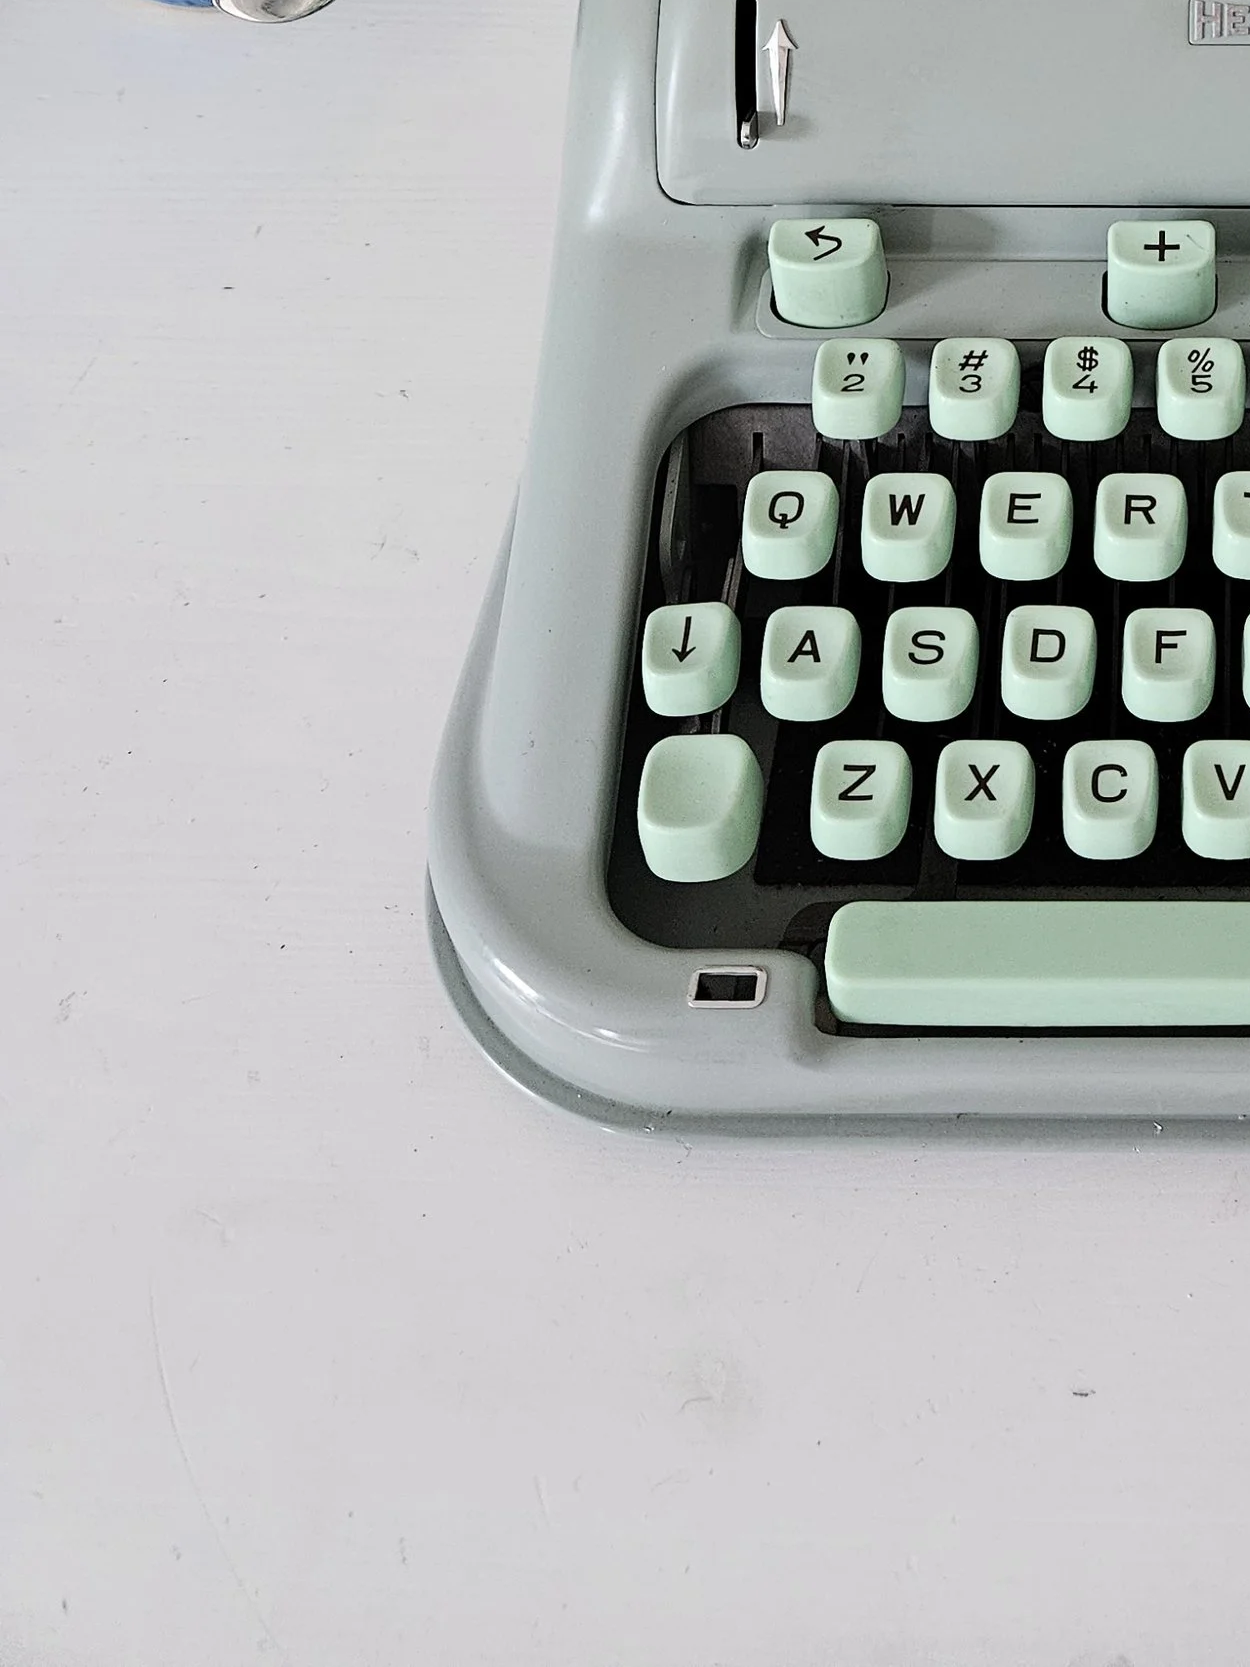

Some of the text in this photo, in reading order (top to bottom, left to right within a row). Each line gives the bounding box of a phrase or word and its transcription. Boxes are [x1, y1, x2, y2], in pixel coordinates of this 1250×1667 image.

[1076, 346, 1099, 372] $
[1187, 347, 1215, 373] %
[840, 373, 865, 392] 2
[959, 374, 982, 393] 3
[1072, 374, 1098, 394] 4
[1190, 374, 1213, 393] 5
[769, 492, 804, 529] Q
[889, 494, 925, 525] W
[1007, 493, 1041, 523] E
[1124, 495, 1156, 524] R
[787, 630, 820, 662] A
[909, 631, 945, 665] S
[1030, 629, 1065, 662] D
[1155, 630, 1186, 663] F
[838, 765, 876, 801] Z
[965, 765, 1000, 801] X
[1092, 764, 1127, 802] C
[1214, 764, 1245, 800] V
